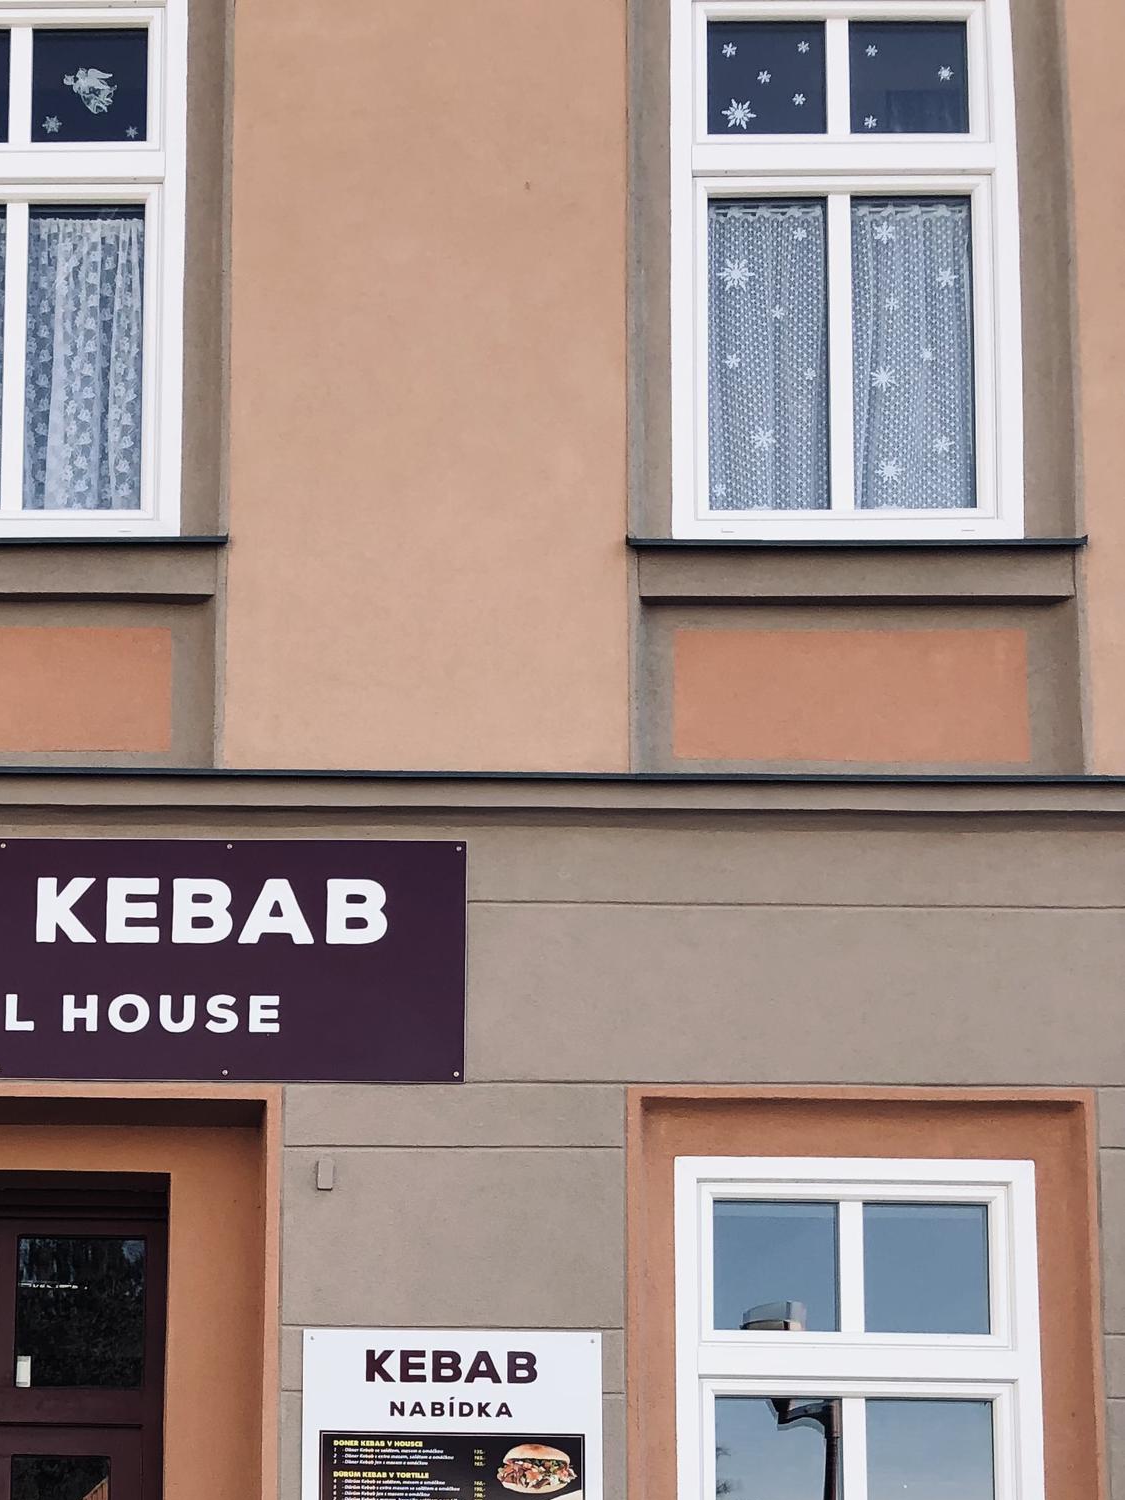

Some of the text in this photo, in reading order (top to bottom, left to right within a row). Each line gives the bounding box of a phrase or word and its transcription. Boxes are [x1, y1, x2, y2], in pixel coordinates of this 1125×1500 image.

[35, 876, 388, 944] KEBAB
[63, 993, 281, 1033] HOUSE
[365, 1350, 538, 1383] KEBAB
[389, 1396, 513, 1418] NABÍDKA
